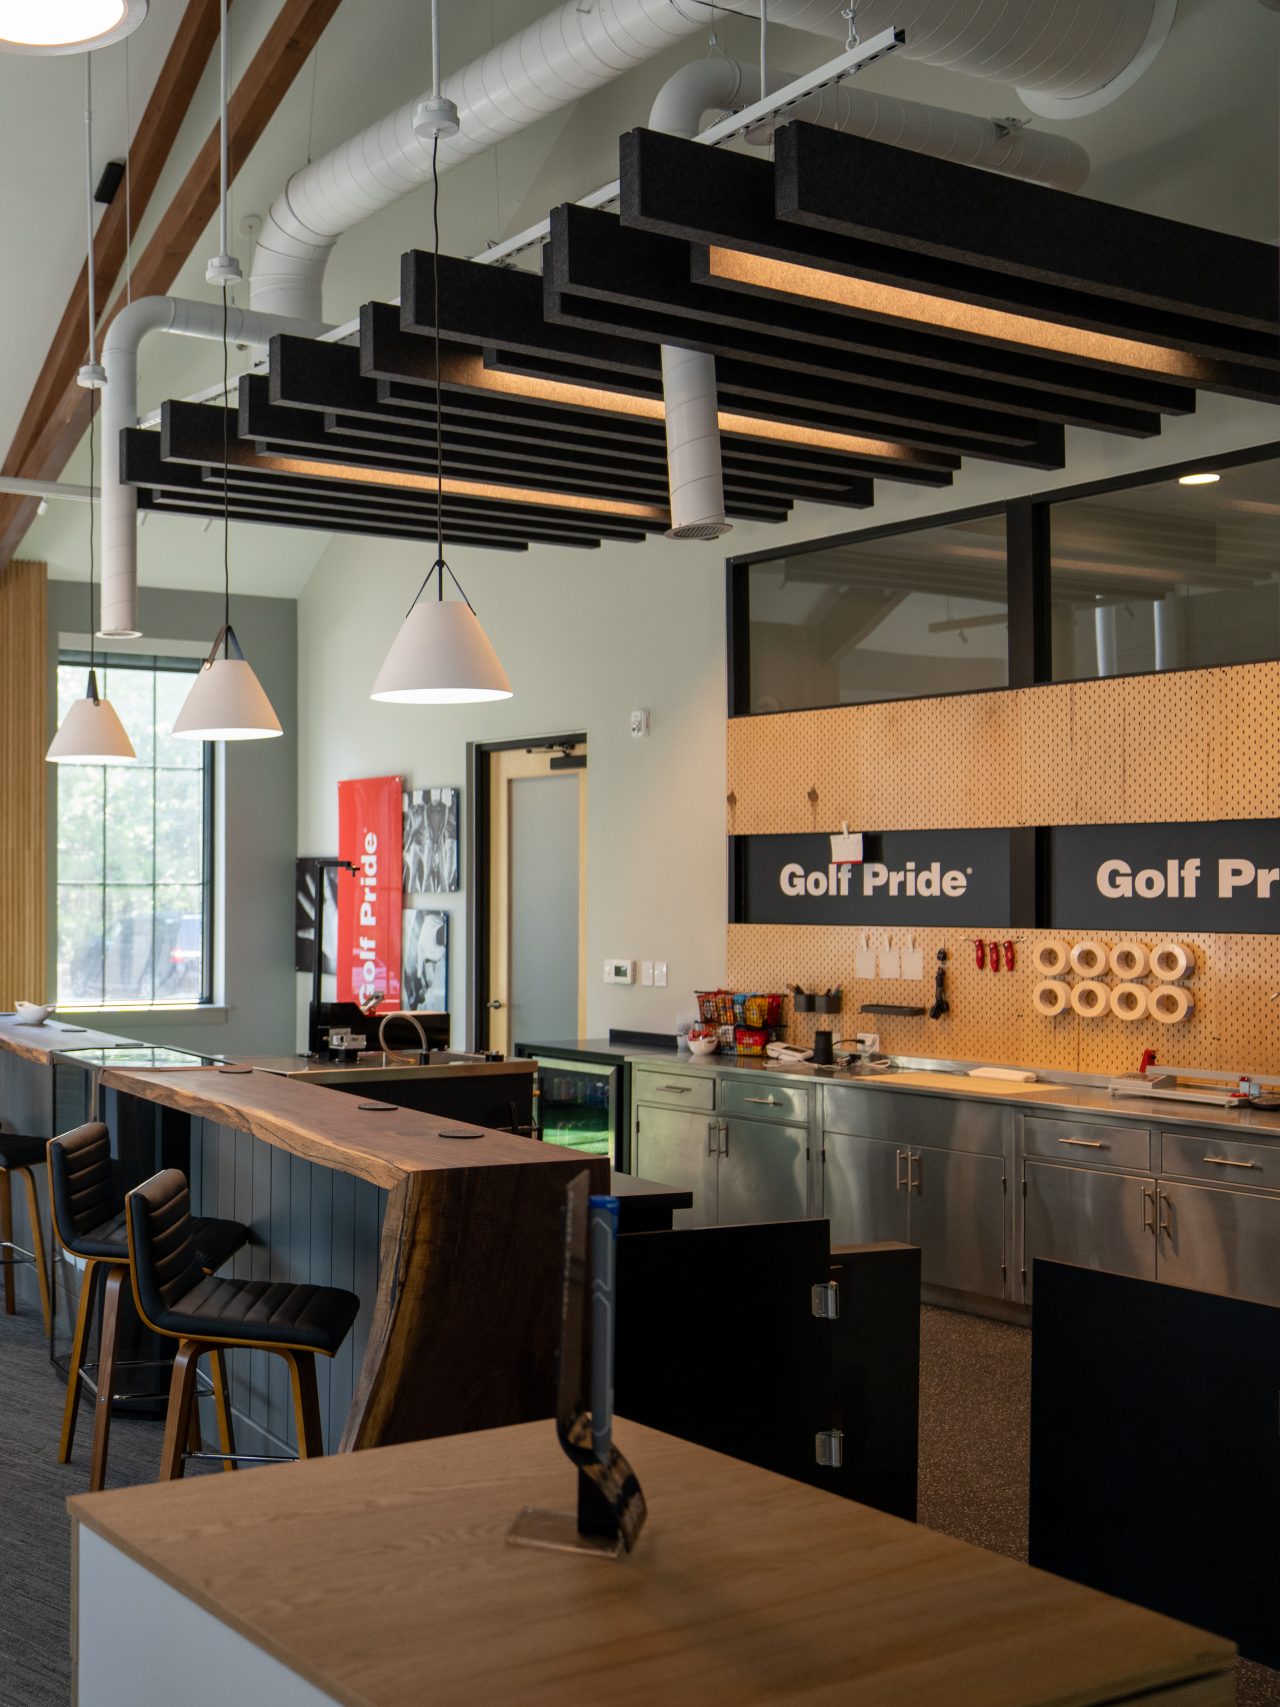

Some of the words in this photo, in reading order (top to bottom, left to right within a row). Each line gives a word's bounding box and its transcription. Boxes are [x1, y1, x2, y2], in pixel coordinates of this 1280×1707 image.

[358, 831, 378, 927] Pride
[779, 862, 852, 897] Golf
[863, 861, 967, 897] Pride
[1096, 857, 1201, 898] Golf
